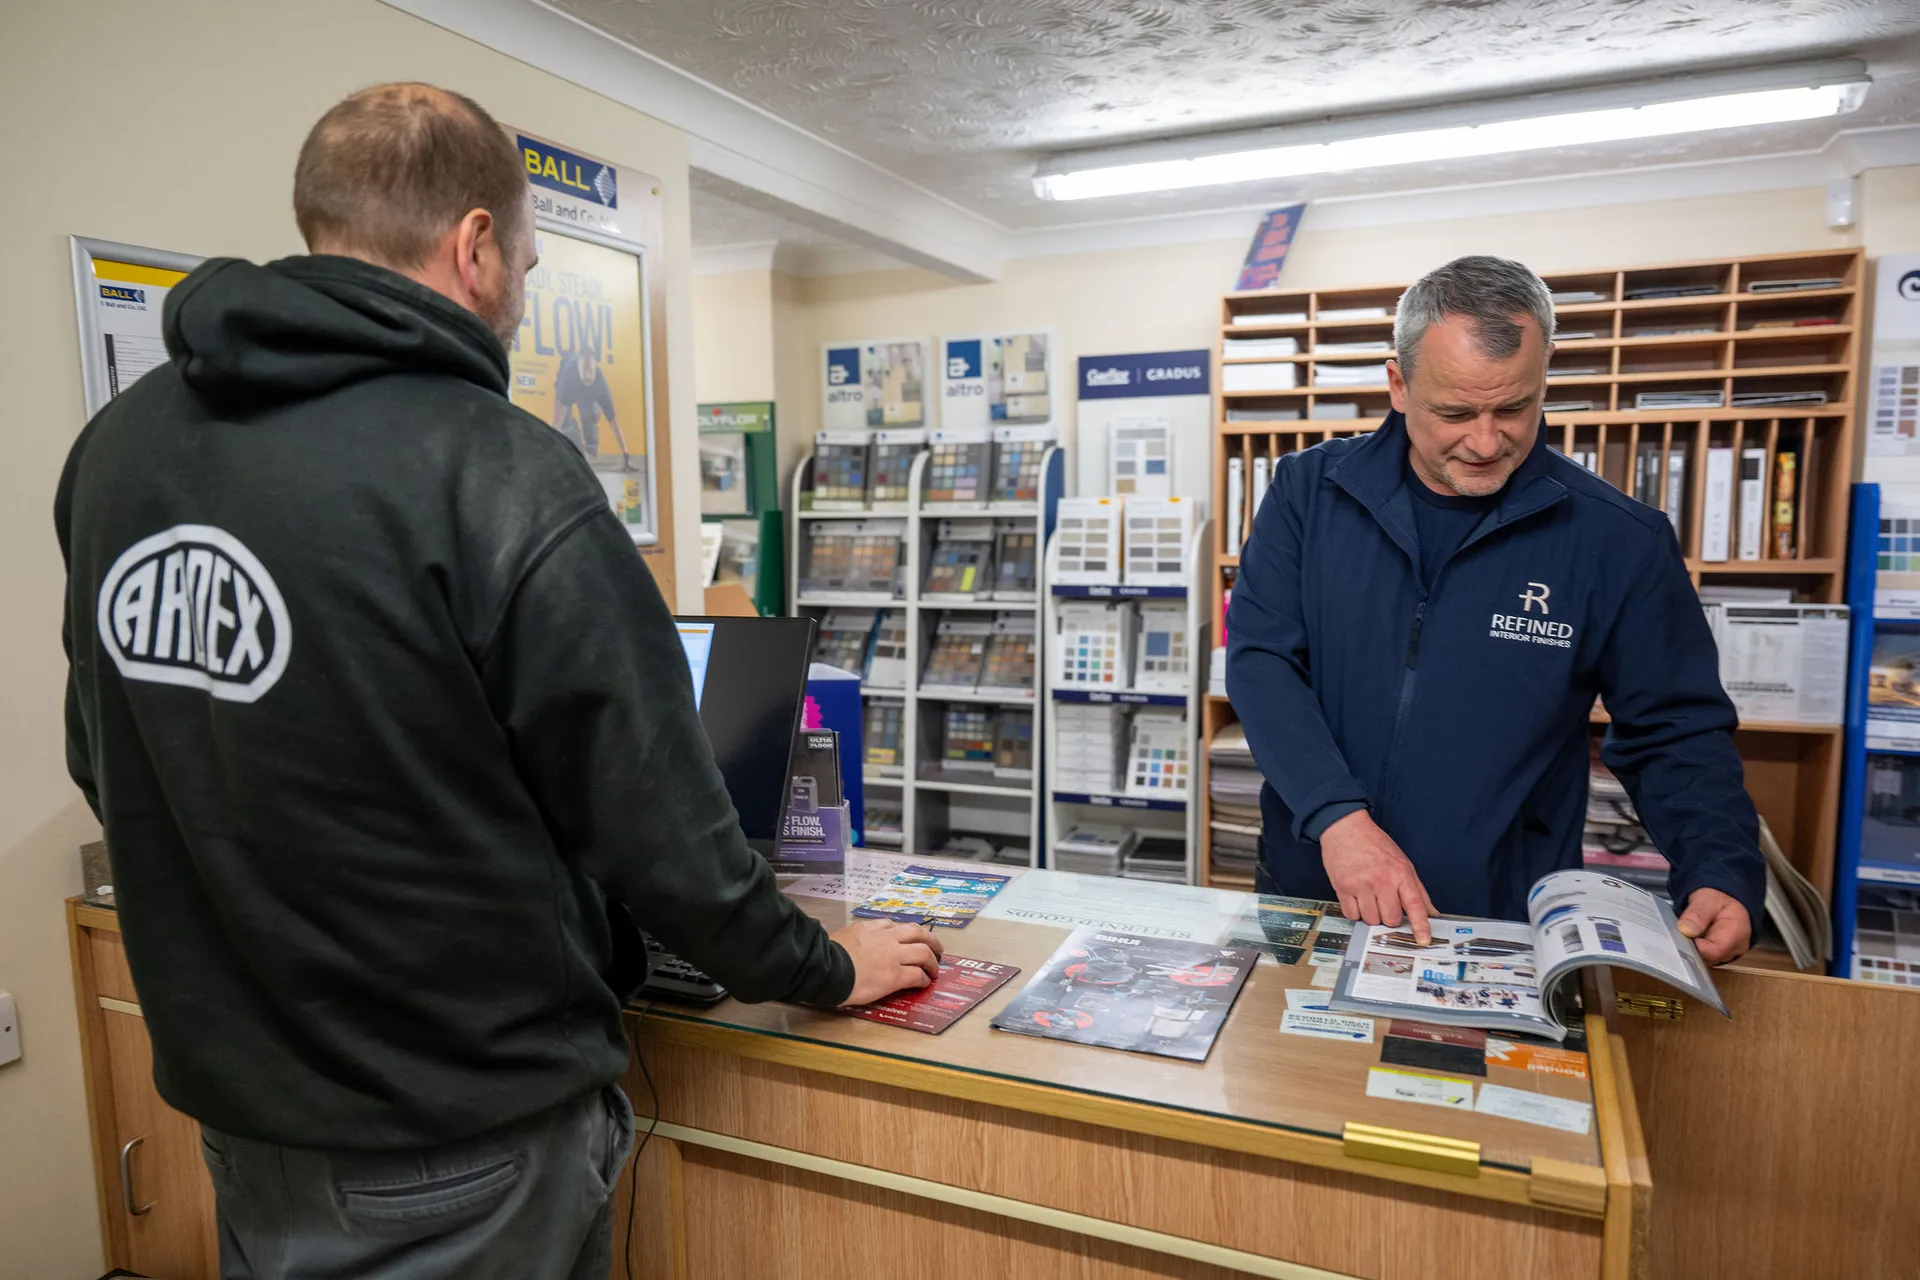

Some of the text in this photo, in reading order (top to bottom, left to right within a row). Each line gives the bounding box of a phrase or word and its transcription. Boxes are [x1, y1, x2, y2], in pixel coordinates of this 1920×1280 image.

[524, 148, 591, 191] BALL
[556, 205, 577, 221] and
[102, 287, 133, 300] BALL
[513, 290, 614, 365] FLOW!
[1146, 366, 1201, 381] GRADUS
[828, 390, 863, 403] altro
[946, 383, 984, 397] altro
[113, 549, 265, 677] ARDEX
[1491, 613, 1574, 639] REFINED
[1489, 630, 1572, 648] INTERIOR FINISHES
[791, 815, 822, 826] FLOW.
[791, 826, 826, 837] FINISH.
[1004, 908, 1074, 925] GOODS
